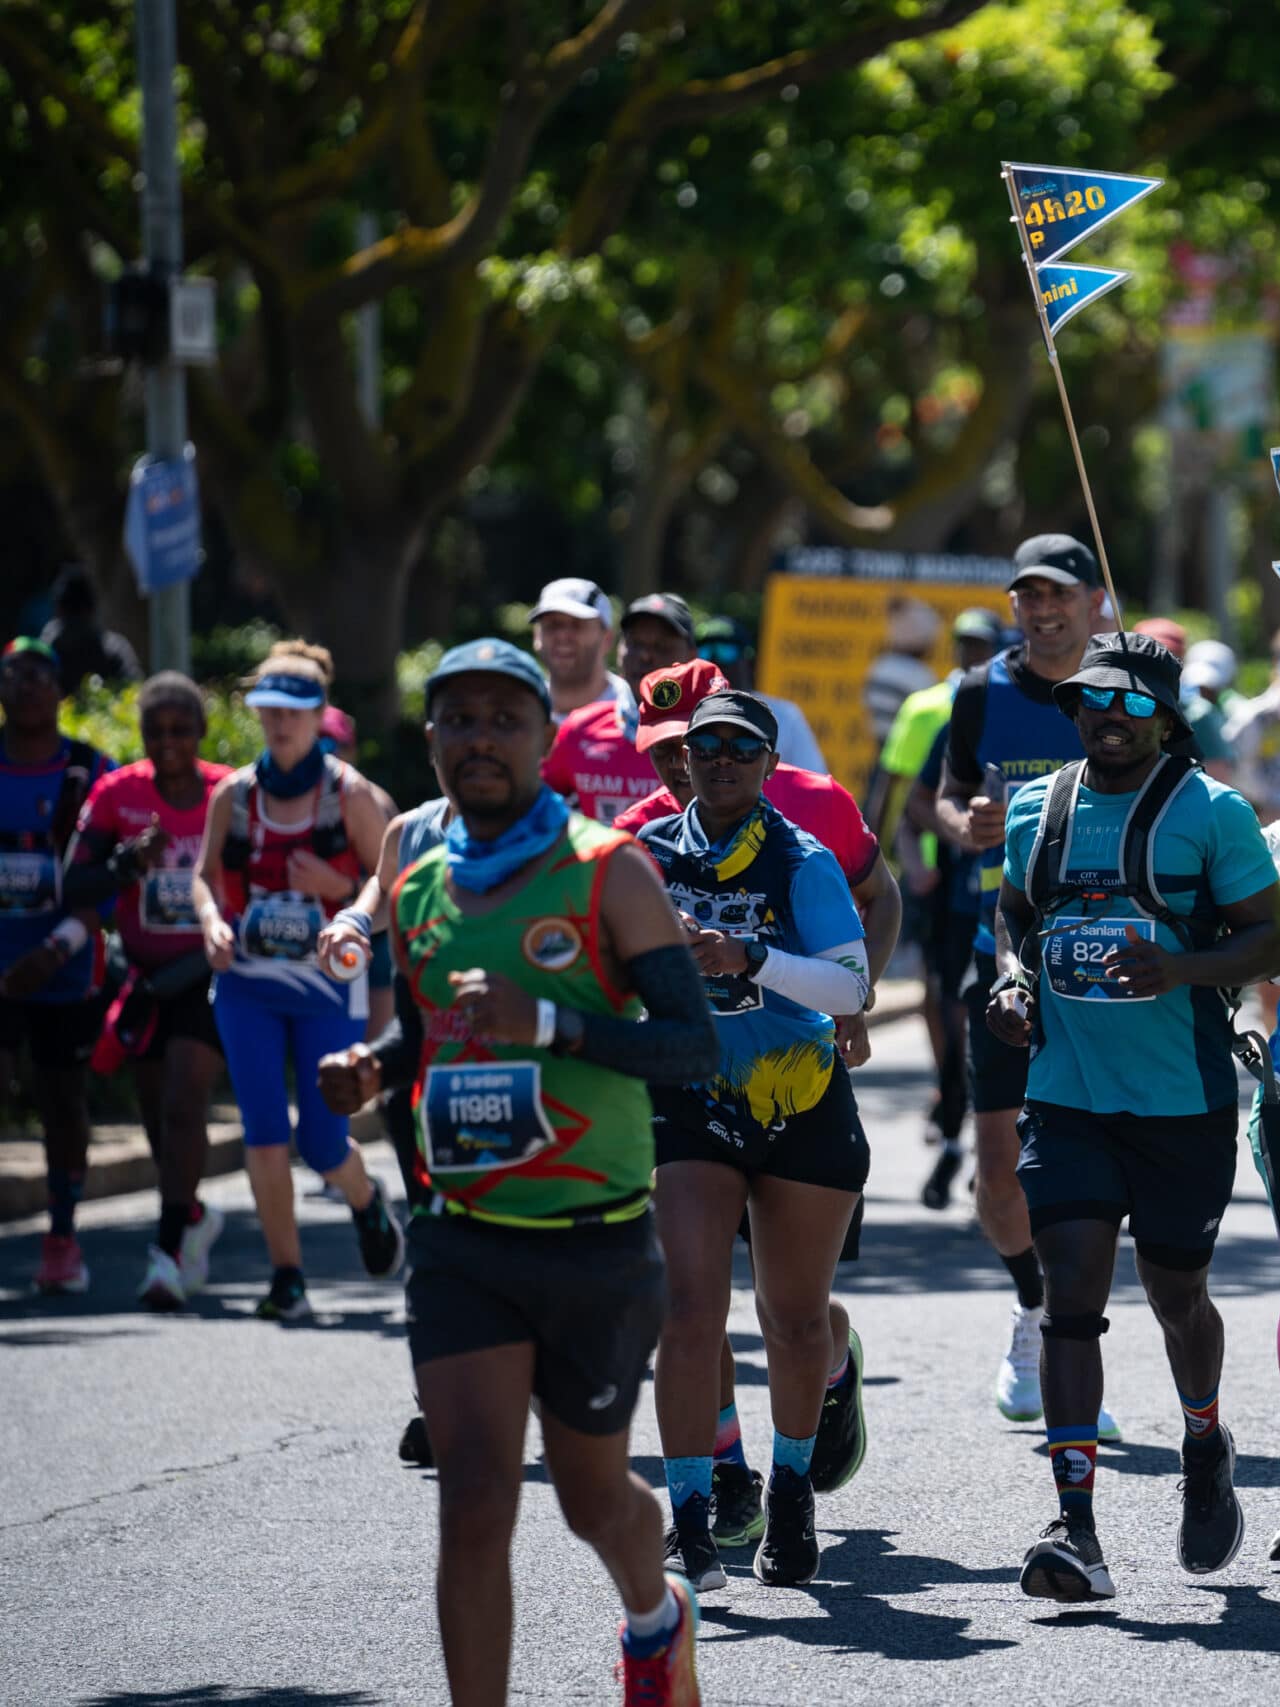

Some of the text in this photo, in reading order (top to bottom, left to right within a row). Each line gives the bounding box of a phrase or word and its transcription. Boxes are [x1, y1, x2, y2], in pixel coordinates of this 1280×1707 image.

[1025, 186, 1106, 226] 4h20
[575, 773, 623, 793] TEAM
[1064, 879, 1100, 887] THLETICS
[1080, 871, 1098, 879] CITY
[1080, 925, 1127, 937] Sanlam
[1051, 936, 1063, 965] PACER
[1073, 941, 1118, 962] 824
[448, 1094, 513, 1123] 11981
[707, 1120, 744, 1149] Santm
